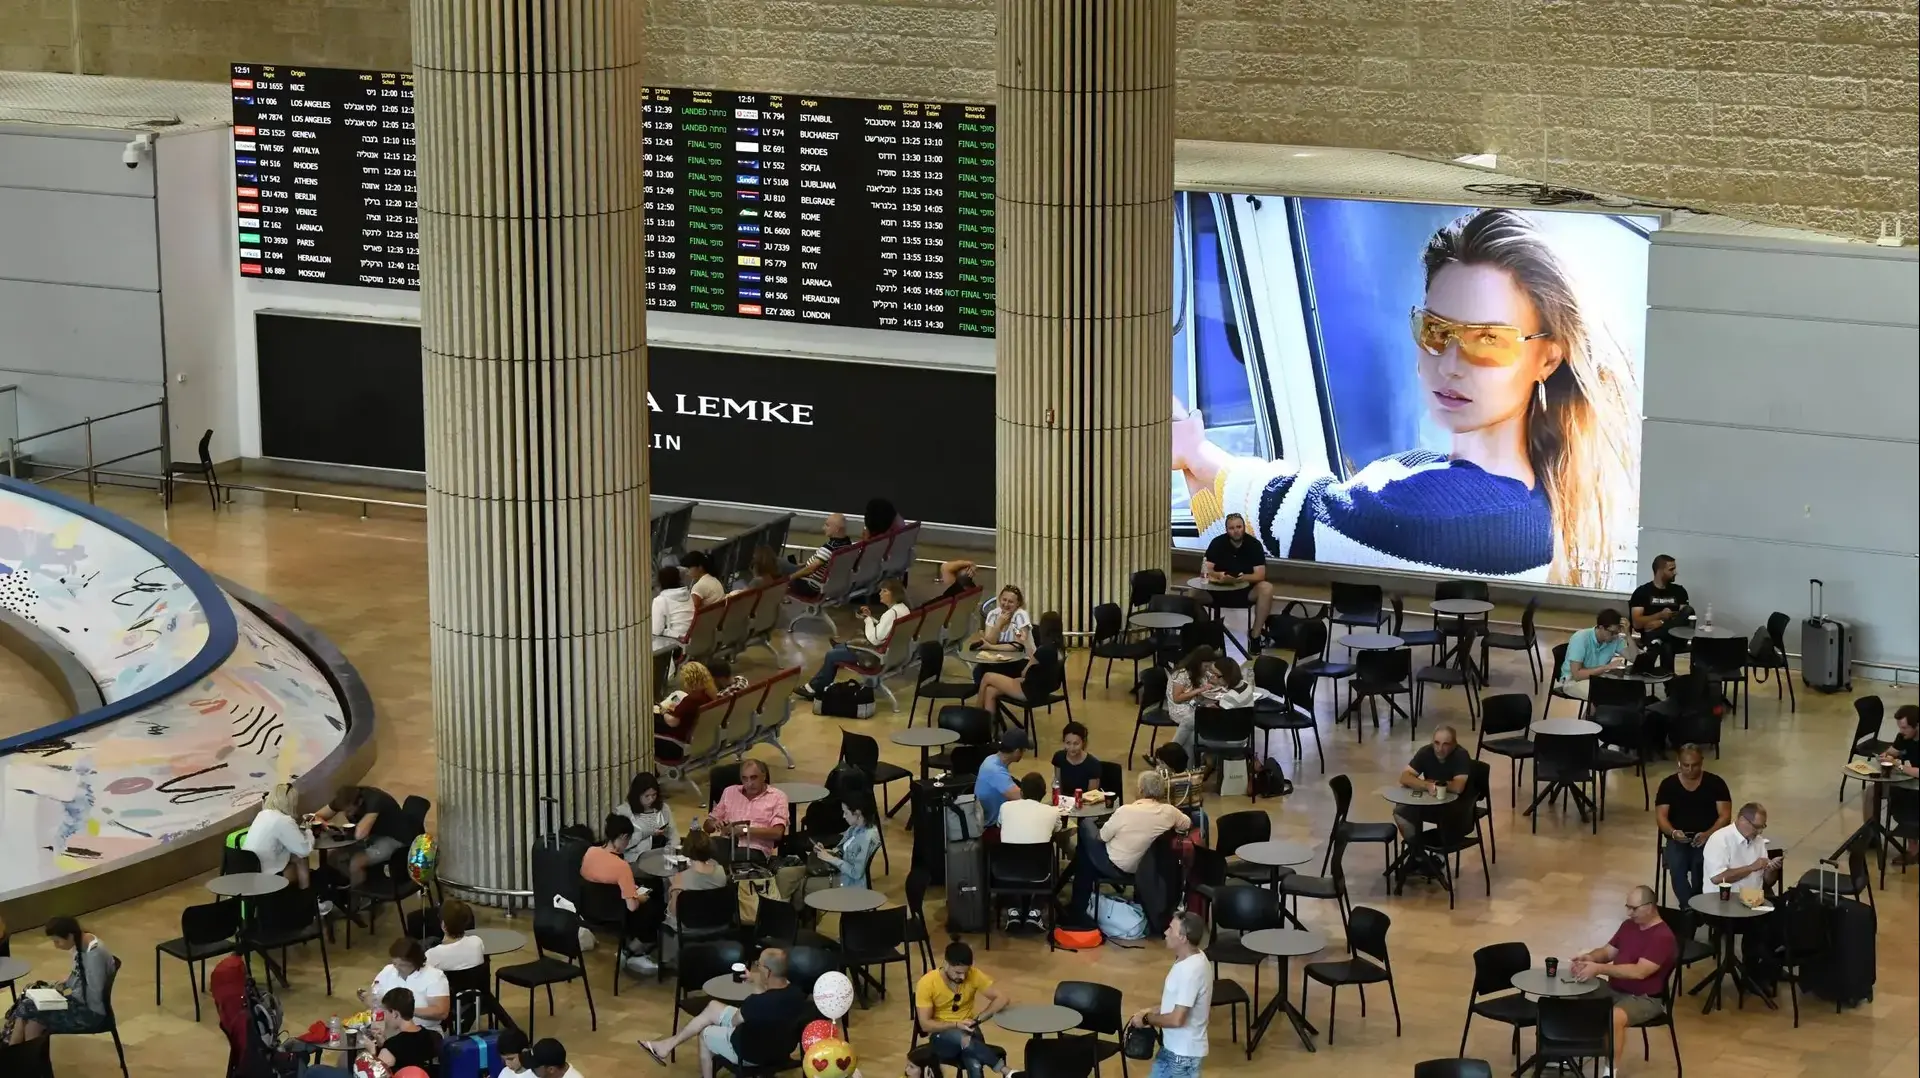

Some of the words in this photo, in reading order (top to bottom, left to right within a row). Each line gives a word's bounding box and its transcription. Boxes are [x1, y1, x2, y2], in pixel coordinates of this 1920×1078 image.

[290, 84, 305, 92] NICE
[290, 99, 303, 107] LOS
[304, 100, 331, 109] ANGELES
[655, 105, 672, 114] 12:39
[681, 107, 708, 116] LANDED
[291, 115, 304, 123] LOS
[304, 116, 331, 124] ANGELES
[762, 112, 771, 120] TK
[773, 112, 785, 120] 794
[800, 114, 833, 123] ISTANBUL
[655, 122, 673, 130] 12:39
[682, 124, 708, 132] LANDED
[902, 120, 921, 128] 13:20
[924, 121, 943, 129] 13:40
[958, 123, 978, 132] FINAL
[292, 130, 316, 139] GENEVA
[762, 128, 771, 136] LY
[800, 130, 839, 140] BUCHAREST
[655, 138, 673, 146] 12:43
[688, 140, 707, 148] FINAL
[902, 137, 921, 145] 13:25
[924, 138, 943, 146] 13:10
[958, 140, 978, 148] FINAL
[292, 146, 320, 155] ANTALYA
[763, 144, 772, 153] BZ
[773, 145, 785, 153] 691
[800, 147, 828, 156] RHODES
[656, 154, 674, 162] 12:46
[902, 153, 921, 162] 13:30
[924, 155, 943, 163] 13:00
[958, 157, 978, 165] FINAL
[293, 161, 318, 170] RHODES
[763, 161, 771, 169] LY
[773, 162, 785, 170] 552
[800, 163, 821, 172] SOFIA
[656, 170, 674, 179] 13:00
[688, 172, 707, 181] FINAL
[902, 170, 921, 178] 13:35
[924, 171, 943, 180] 13:23
[958, 174, 978, 182] FINAL
[294, 177, 318, 185] ATHENS
[738, 175, 759, 185] Sundor
[763, 177, 772, 185] LY
[773, 178, 789, 186] 5108
[801, 180, 836, 189] LJUBLJANA
[656, 187, 674, 195] 12:49
[902, 187, 921, 195] 13:35
[924, 188, 943, 197] 13:43
[958, 190, 978, 199] FINAL
[295, 192, 316, 201] BERLIN
[763, 194, 772, 202] JU
[773, 194, 786, 202] 810
[801, 196, 835, 206] BELGRADE
[657, 203, 675, 211] 12:50
[689, 205, 708, 213] FINAL
[903, 203, 921, 212] 13:50
[924, 205, 943, 213] 14:05
[958, 207, 978, 216] FINAL
[295, 208, 317, 216] VENICE
[764, 210, 773, 218] AZ
[774, 211, 786, 219] 806
[801, 212, 820, 221] ROME
[657, 219, 675, 227] 13:10
[903, 220, 921, 228] 13:55
[925, 221, 943, 230] 13:50
[296, 224, 323, 232] LARNACA
[764, 226, 773, 234] DL
[774, 227, 791, 235] 6600
[958, 224, 978, 232] FINAL
[801, 229, 821, 238] ROME
[297, 239, 315, 247] PARIS
[658, 235, 675, 243] 13:20
[689, 237, 708, 246] FINAL
[903, 236, 921, 245] 13:55
[925, 238, 943, 246] 13:50
[774, 243, 790, 252] 7339
[959, 240, 978, 249] FINAL
[801, 245, 821, 254] ROME
[297, 254, 331, 263] HERAKLION
[658, 251, 676, 259] 13:09
[903, 253, 922, 261] 13:55
[925, 255, 944, 263] 13:50
[764, 259, 773, 267] PS
[774, 259, 787, 268] 779
[959, 257, 978, 265] FINAL
[802, 262, 818, 270] KYIV
[298, 269, 326, 278] MOSCOW
[658, 267, 676, 275] 13:09
[903, 269, 922, 278] 14:00
[925, 271, 944, 279] 13:55
[765, 275, 774, 283] 6H
[775, 276, 788, 284] 588
[959, 273, 978, 282] FINAL
[802, 278, 832, 287] LARNACA
[690, 285, 709, 294] FINAL
[903, 286, 922, 294] 14:05
[925, 288, 944, 296] 14:05
[944, 289, 959, 297] NOT
[961, 290, 981, 299] FINAL
[765, 291, 774, 299] 6H
[776, 292, 788, 300] 506
[802, 294, 840, 304] HERAKLION
[659, 299, 677, 307] 13:20
[691, 301, 709, 310] FINAL
[903, 302, 922, 311] 14:10
[765, 307, 778, 315] EZY
[779, 308, 795, 317] 2083
[925, 304, 944, 312] 14:00
[959, 307, 978, 315] FINAL
[802, 310, 831, 319] LONDON
[903, 319, 922, 327] 14:15
[925, 320, 944, 329] 14:30
[959, 323, 979, 332] FINAL
[675, 393, 814, 425] LEMKE
[648, 434, 680, 450] IN
